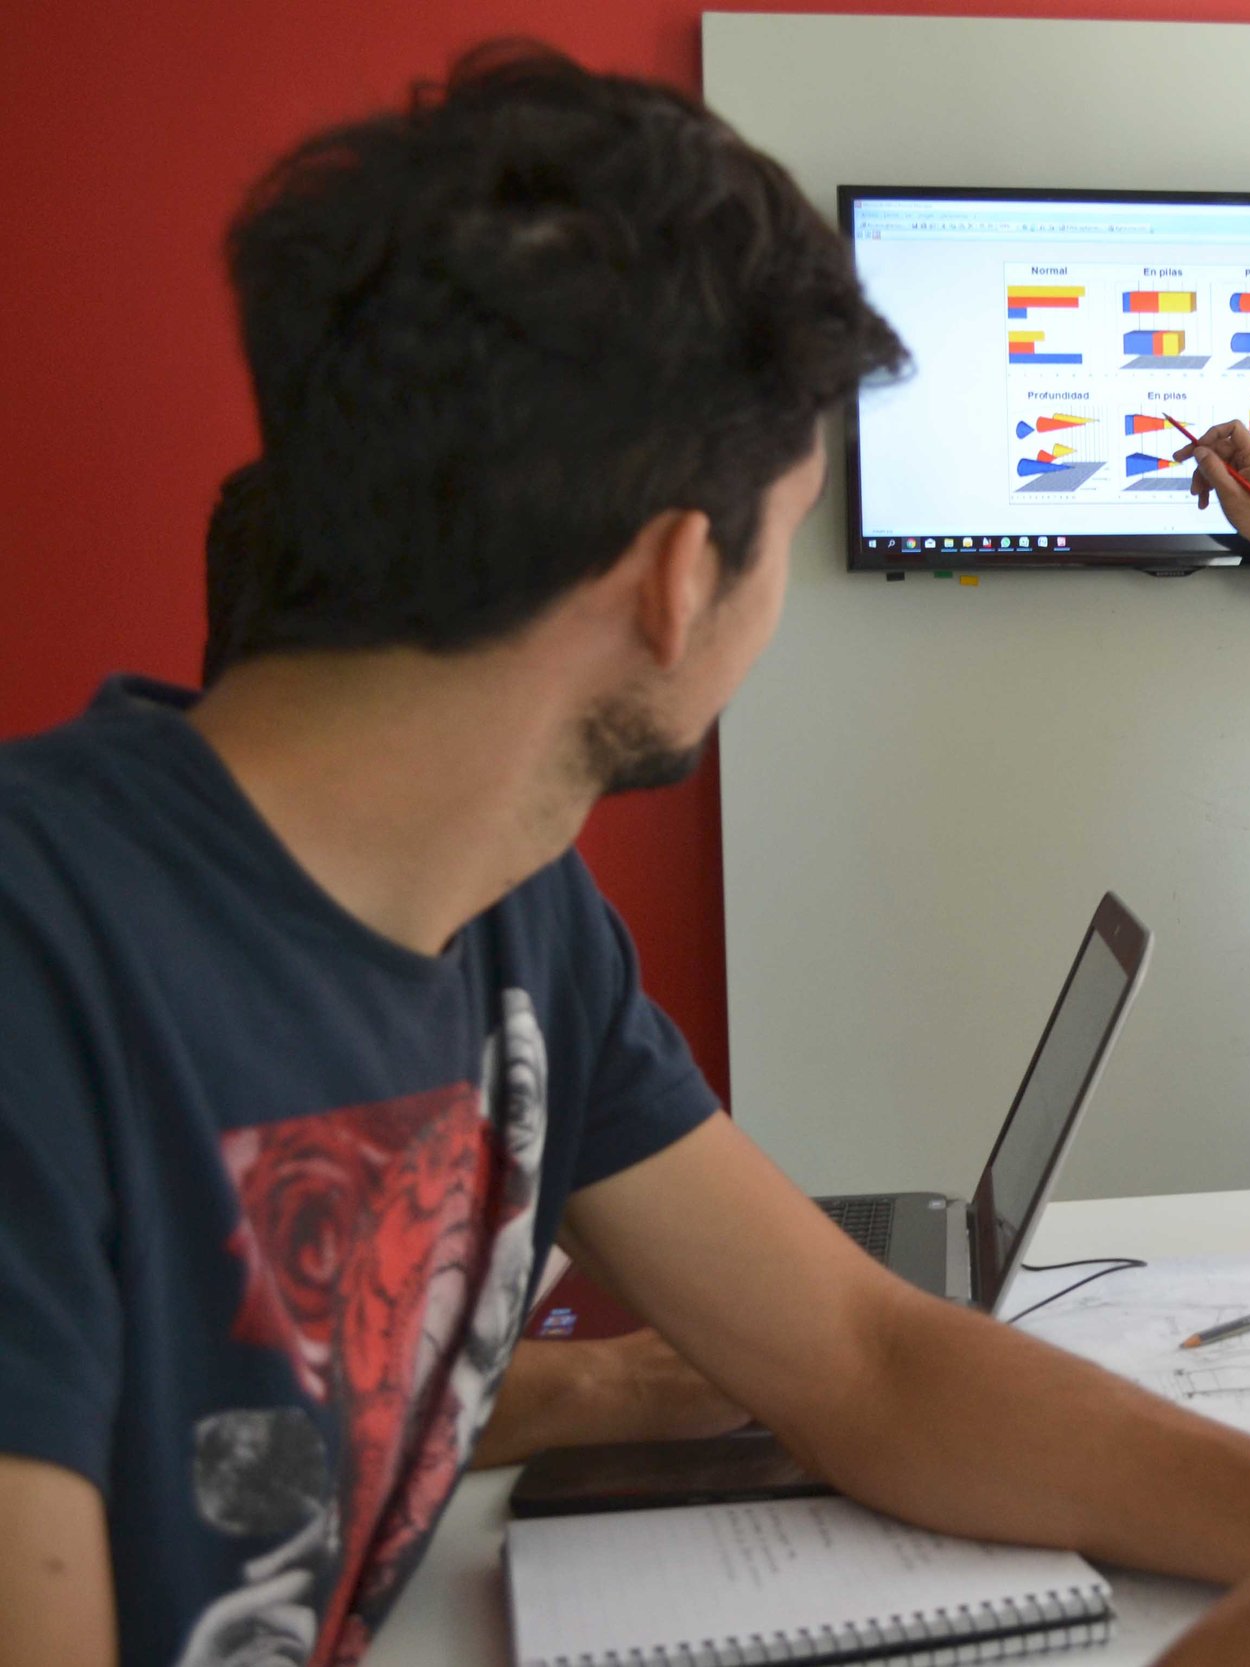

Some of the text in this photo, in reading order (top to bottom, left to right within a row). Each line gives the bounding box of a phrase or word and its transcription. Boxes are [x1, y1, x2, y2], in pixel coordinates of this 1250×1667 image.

[1031, 265, 1068, 276] Normal
[1143, 267, 1183, 279] En pilas
[1027, 390, 1090, 401] Profundidad
[1147, 391, 1187, 403] En pilas
